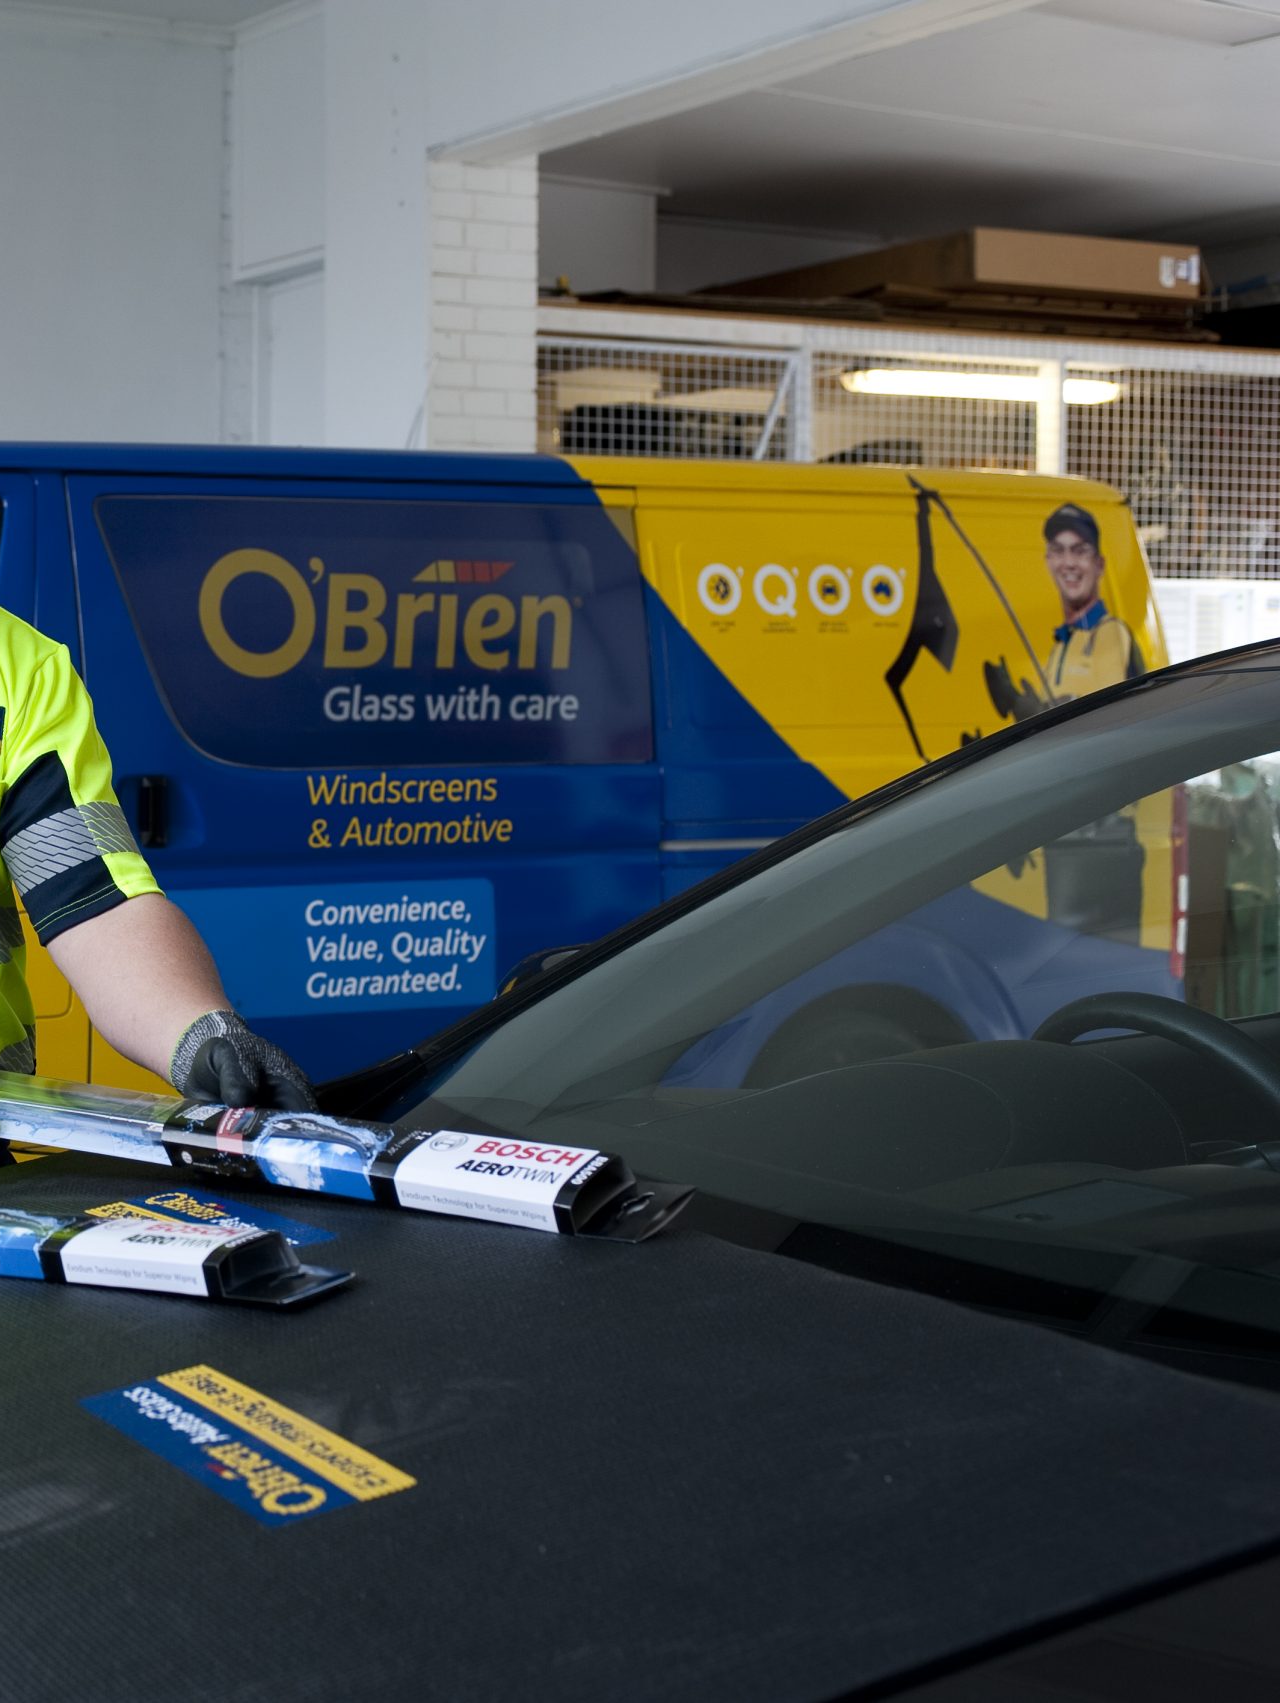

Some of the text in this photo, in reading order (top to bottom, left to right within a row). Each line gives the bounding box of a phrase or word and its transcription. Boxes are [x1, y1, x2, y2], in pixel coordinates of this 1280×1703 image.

[198, 547, 574, 679] O'Brien
[323, 683, 579, 722] Glass with care
[307, 772, 498, 806] Windscreens
[308, 813, 514, 849] & Automotive
[305, 895, 472, 927] Convenience,
[306, 928, 487, 964] Value, Quality
[306, 963, 462, 999] Guaranteed.
[474, 1140, 585, 1167] BOSCH
[456, 1159, 563, 1185] AEROTWIN
[433, 1195, 474, 1210] Technology
[475, 1202, 486, 1210] for
[487, 1203, 520, 1217] Superior
[521, 1210, 548, 1223] Wiping
